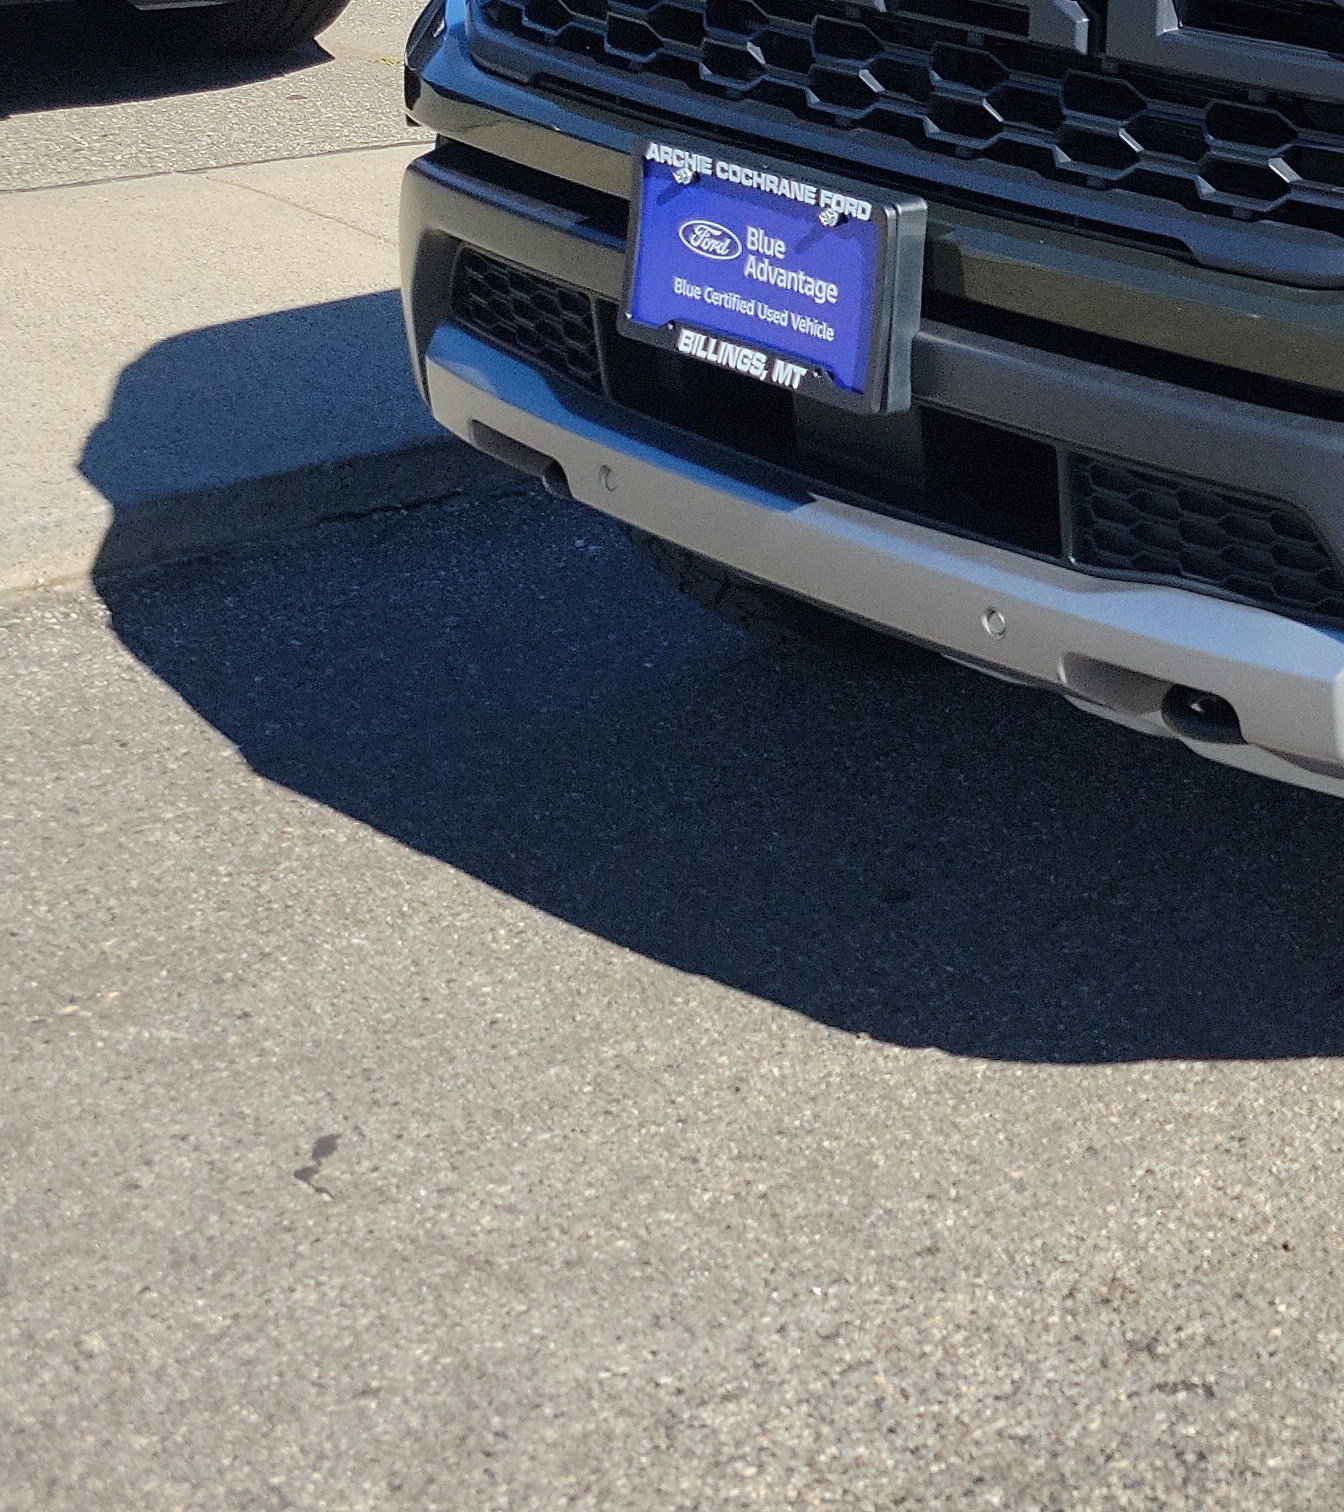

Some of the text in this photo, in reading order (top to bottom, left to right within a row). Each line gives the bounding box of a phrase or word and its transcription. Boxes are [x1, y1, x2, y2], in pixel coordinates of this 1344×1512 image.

[645, 141, 872, 221] ARCHIE COCHRANE FORD
[689, 223, 731, 256] Ford
[745, 226, 787, 259] Blue
[743, 253, 839, 304] Advantage
[673, 275, 836, 342] Blue Certified Used Vehicle
[677, 328, 808, 389] BILLINGS, MT
